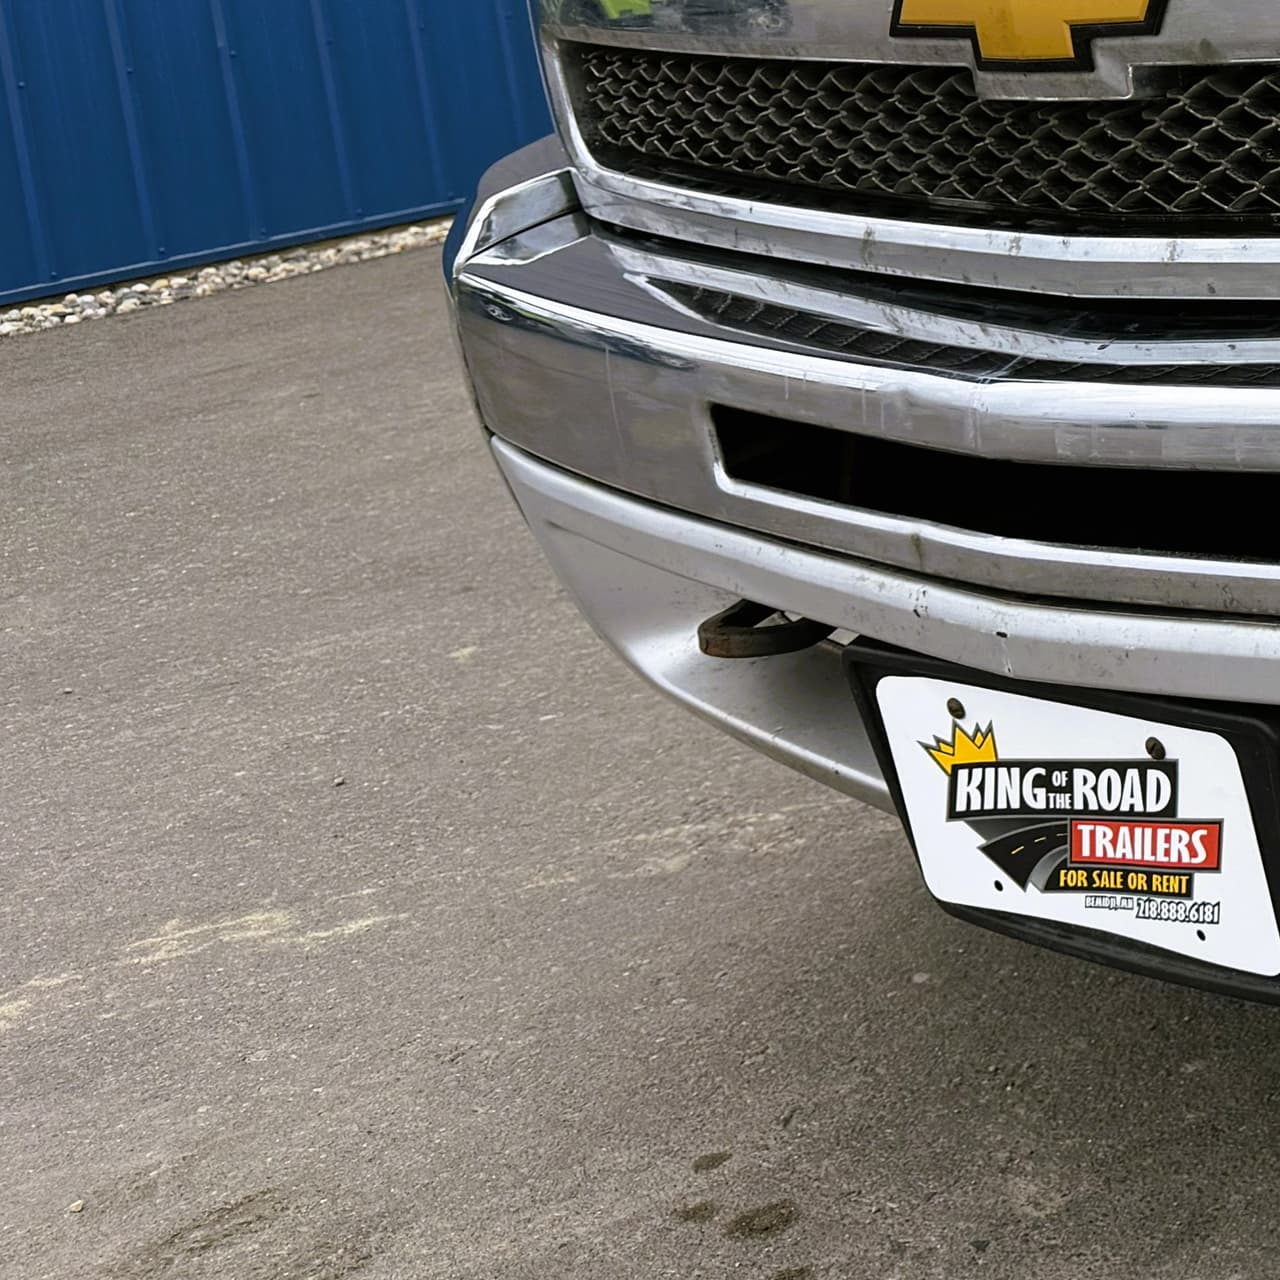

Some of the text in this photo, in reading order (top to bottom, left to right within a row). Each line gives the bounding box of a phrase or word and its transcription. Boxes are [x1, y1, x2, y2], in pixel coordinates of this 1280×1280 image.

[954, 768, 1172, 813] KING OF THE ROAD
[1078, 825, 1207, 864] TRAILERS
[1059, 870, 1189, 894] FOR SALE OR RENT
[1136, 898, 1220, 924] 218.888.6181
